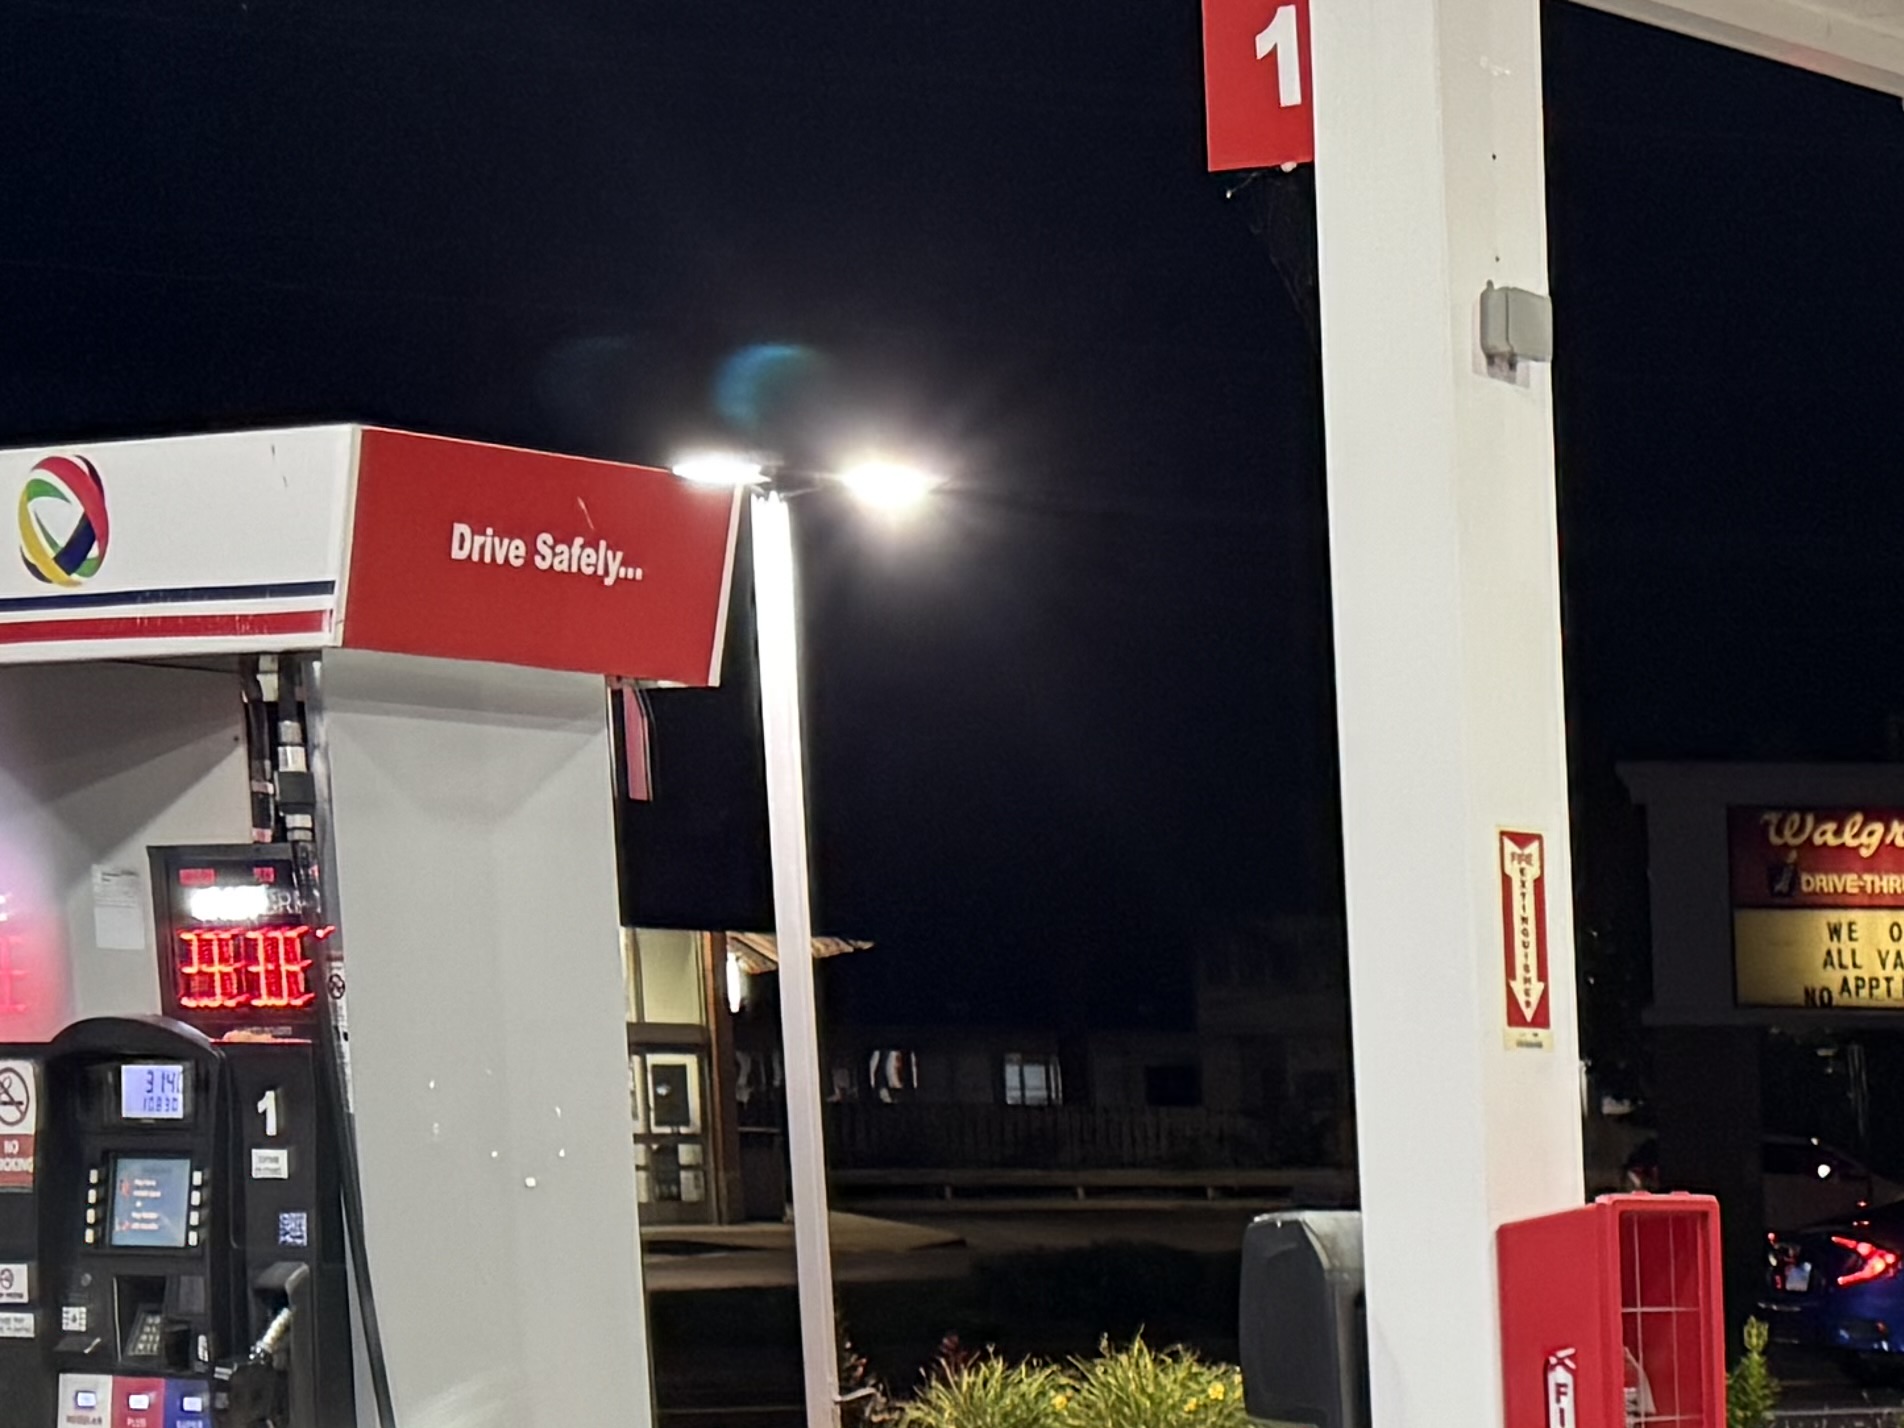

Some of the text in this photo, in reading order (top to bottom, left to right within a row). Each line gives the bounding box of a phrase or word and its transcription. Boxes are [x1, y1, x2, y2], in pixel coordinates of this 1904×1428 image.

[1254, 4, 1302, 107] 1
[451, 522, 527, 567] Drive
[1827, 920, 1860, 943] WE
[1822, 949, 1863, 971] ALL
[1839, 975, 1894, 999] APPT
[257, 1090, 278, 1136] 1
